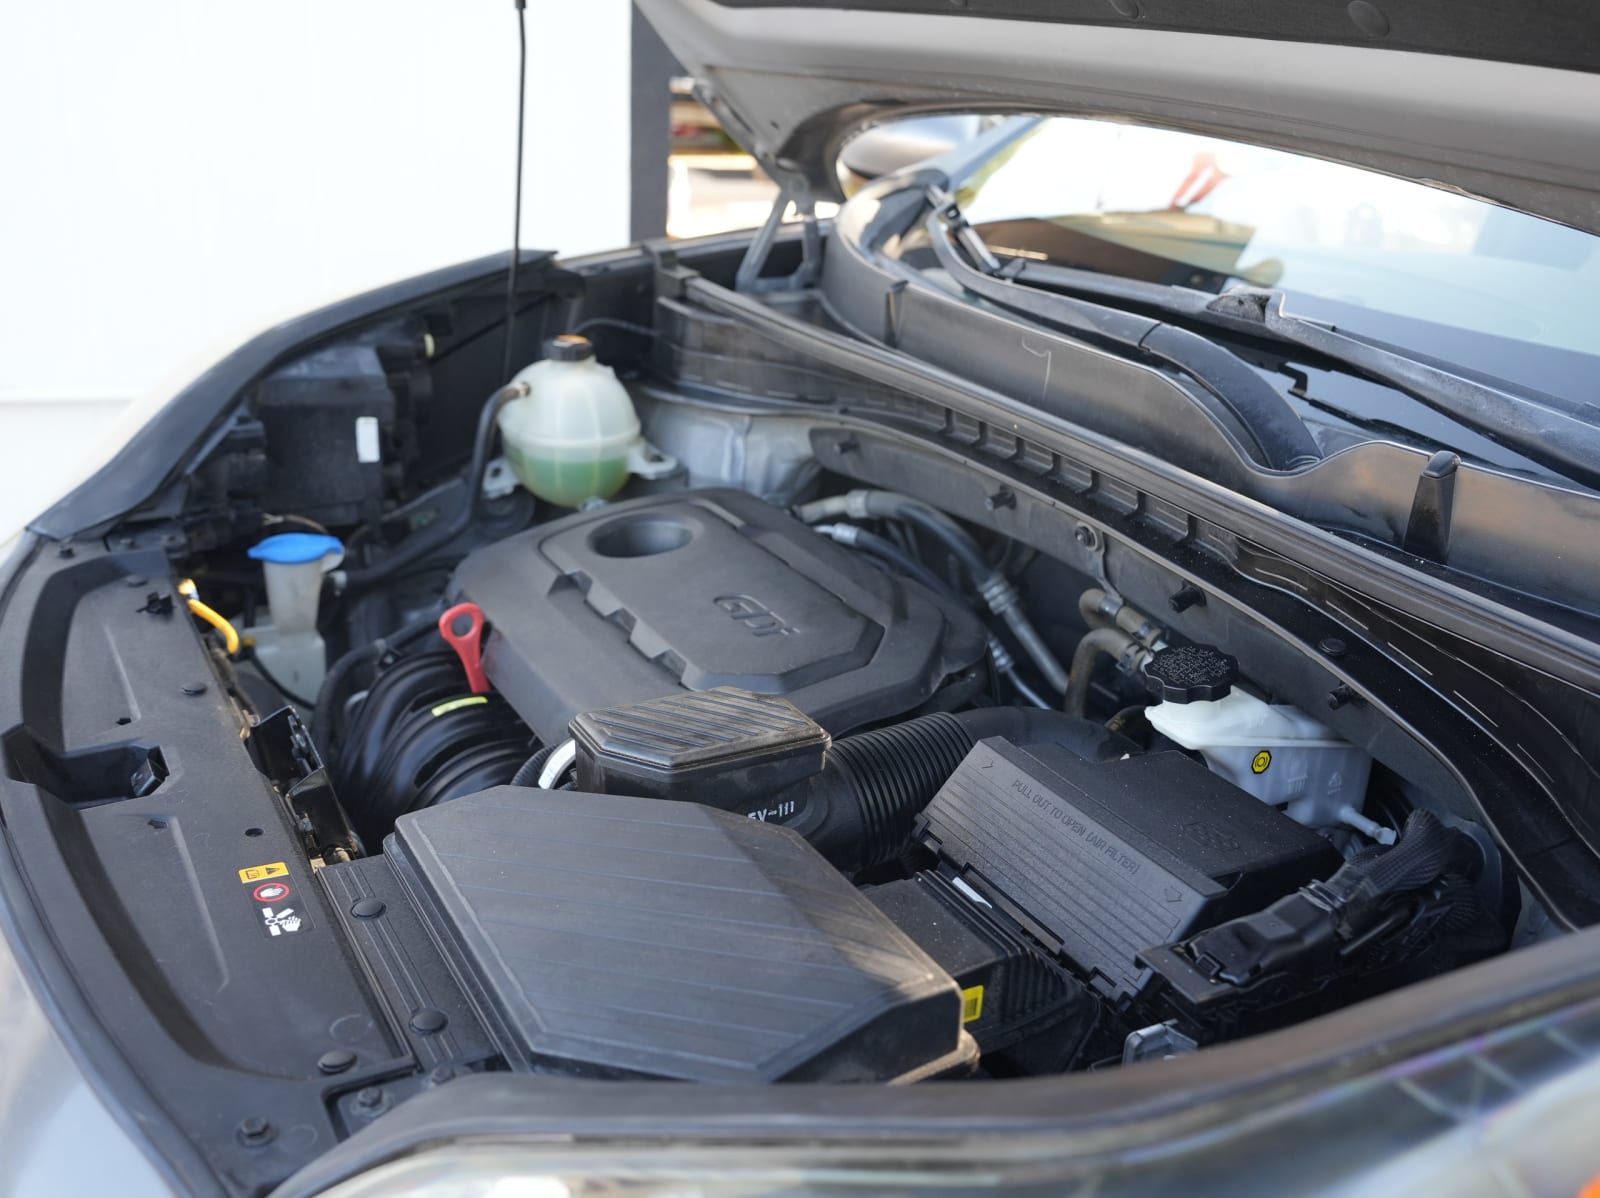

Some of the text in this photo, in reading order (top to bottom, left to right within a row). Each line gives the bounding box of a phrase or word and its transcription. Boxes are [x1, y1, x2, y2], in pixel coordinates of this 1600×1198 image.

[1011, 779, 1032, 799] PULL
[1032, 794, 1052, 810] OUT
[1049, 806, 1064, 820] TO
[1061, 815, 1087, 837] OPEN
